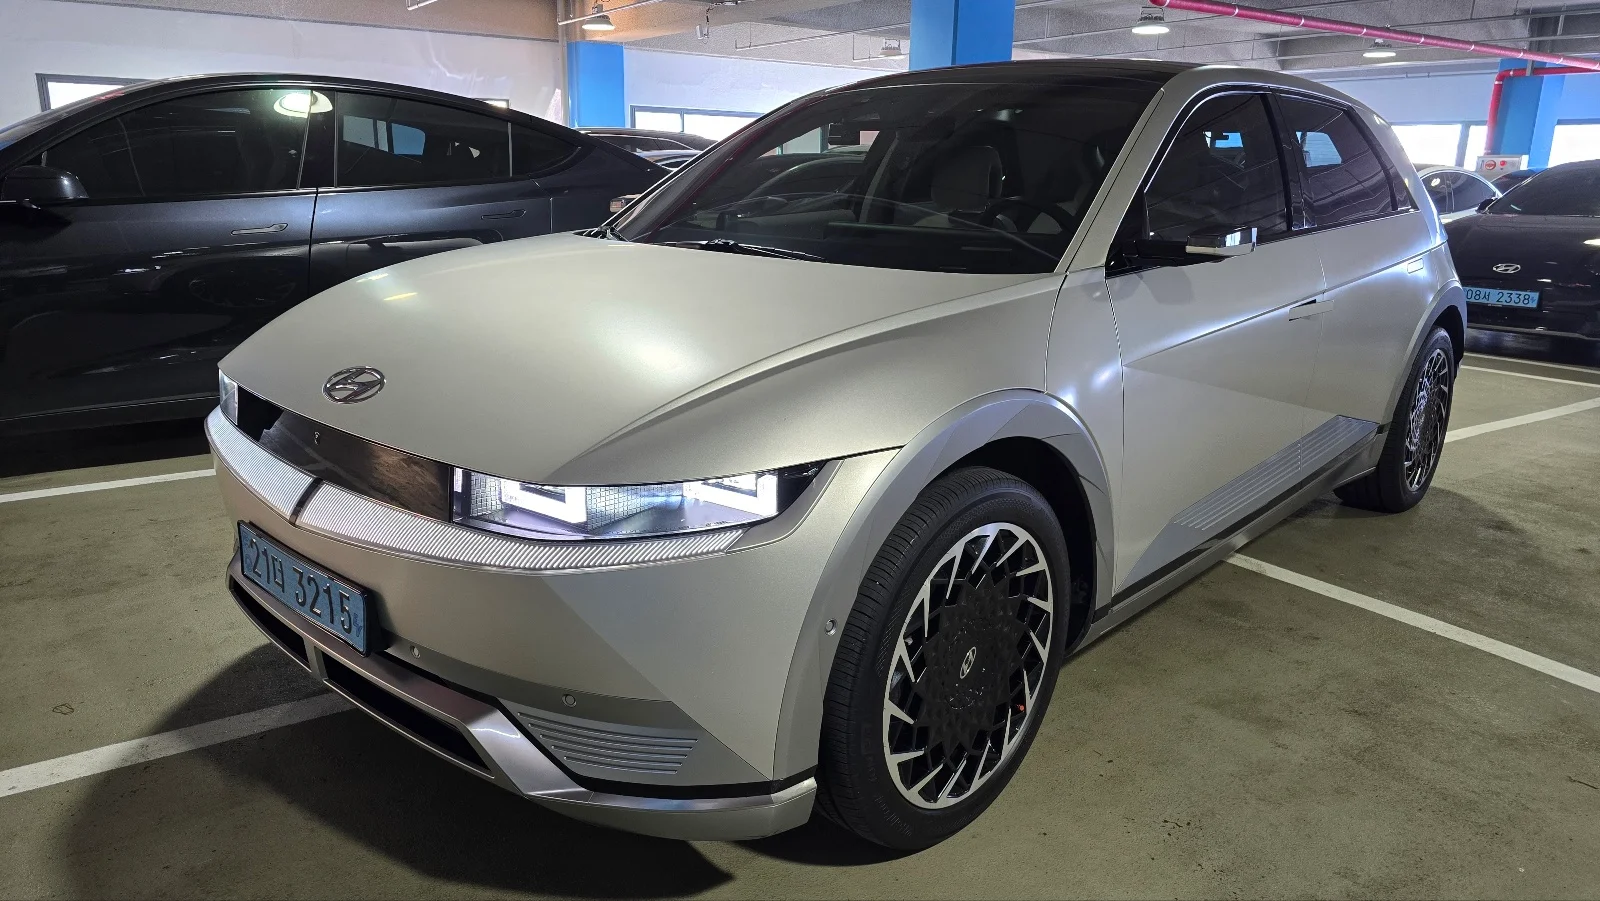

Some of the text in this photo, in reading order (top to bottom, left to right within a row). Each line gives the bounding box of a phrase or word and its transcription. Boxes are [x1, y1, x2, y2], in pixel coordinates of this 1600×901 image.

[1466, 289, 1490, 302] 08서
[1496, 291, 1531, 306] 2338
[249, 538, 353, 635] 21더 3215
